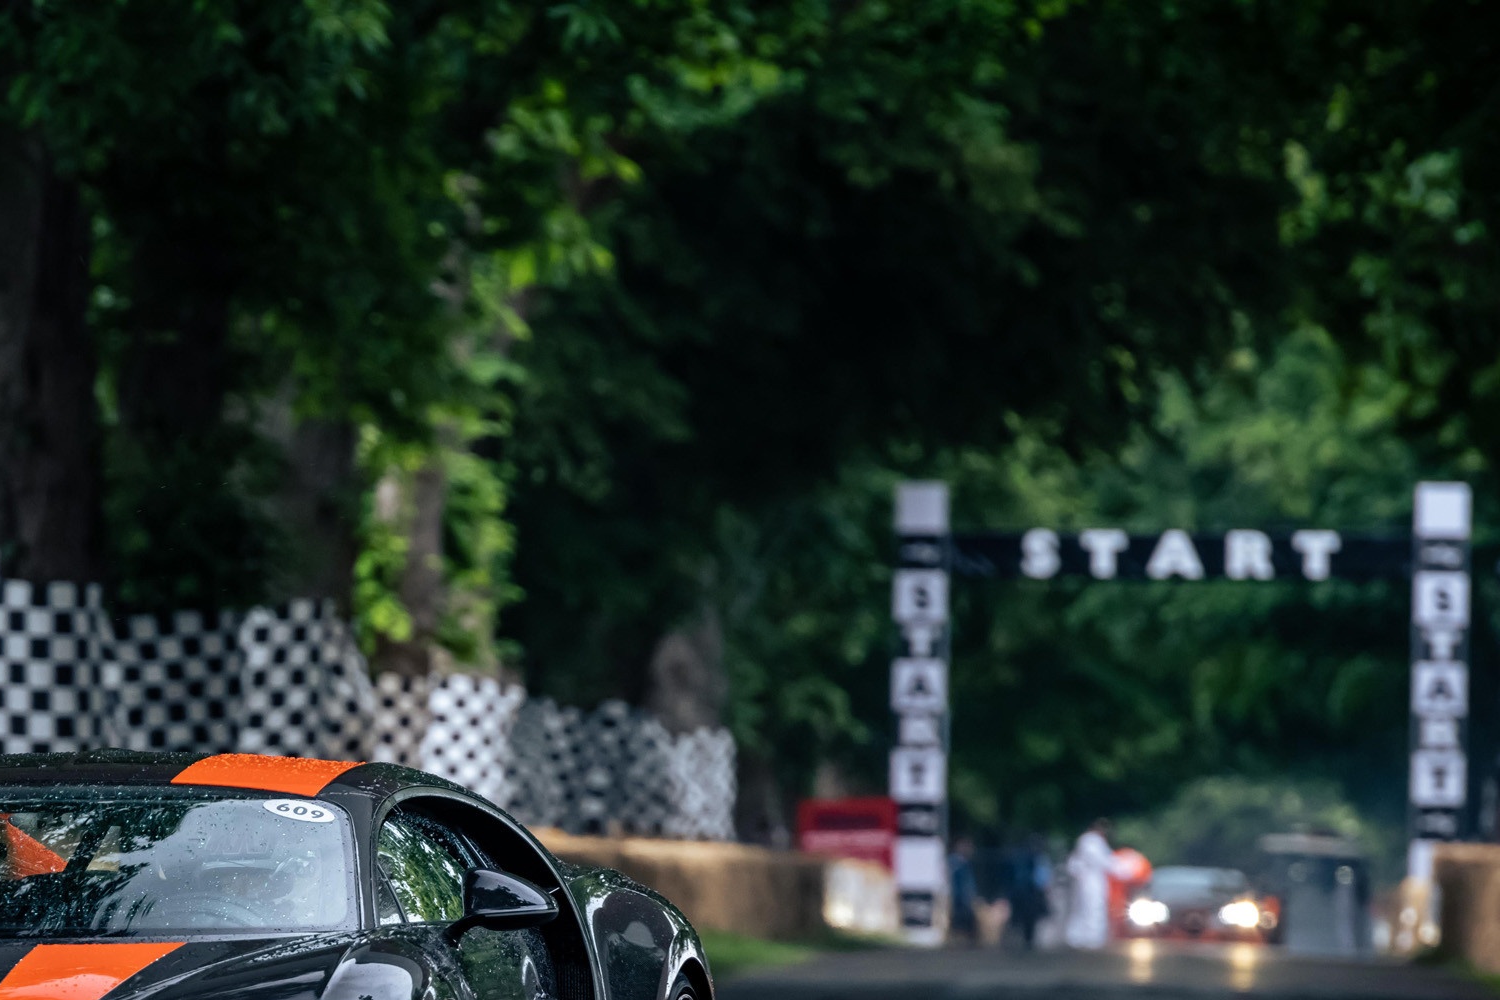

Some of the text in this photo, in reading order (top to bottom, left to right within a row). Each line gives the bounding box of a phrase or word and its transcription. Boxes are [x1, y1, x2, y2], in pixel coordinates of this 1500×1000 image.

[1020, 527, 1342, 581] START
[899, 580, 943, 793] START
[1417, 583, 1462, 796] START
[276, 803, 324, 818] 609
